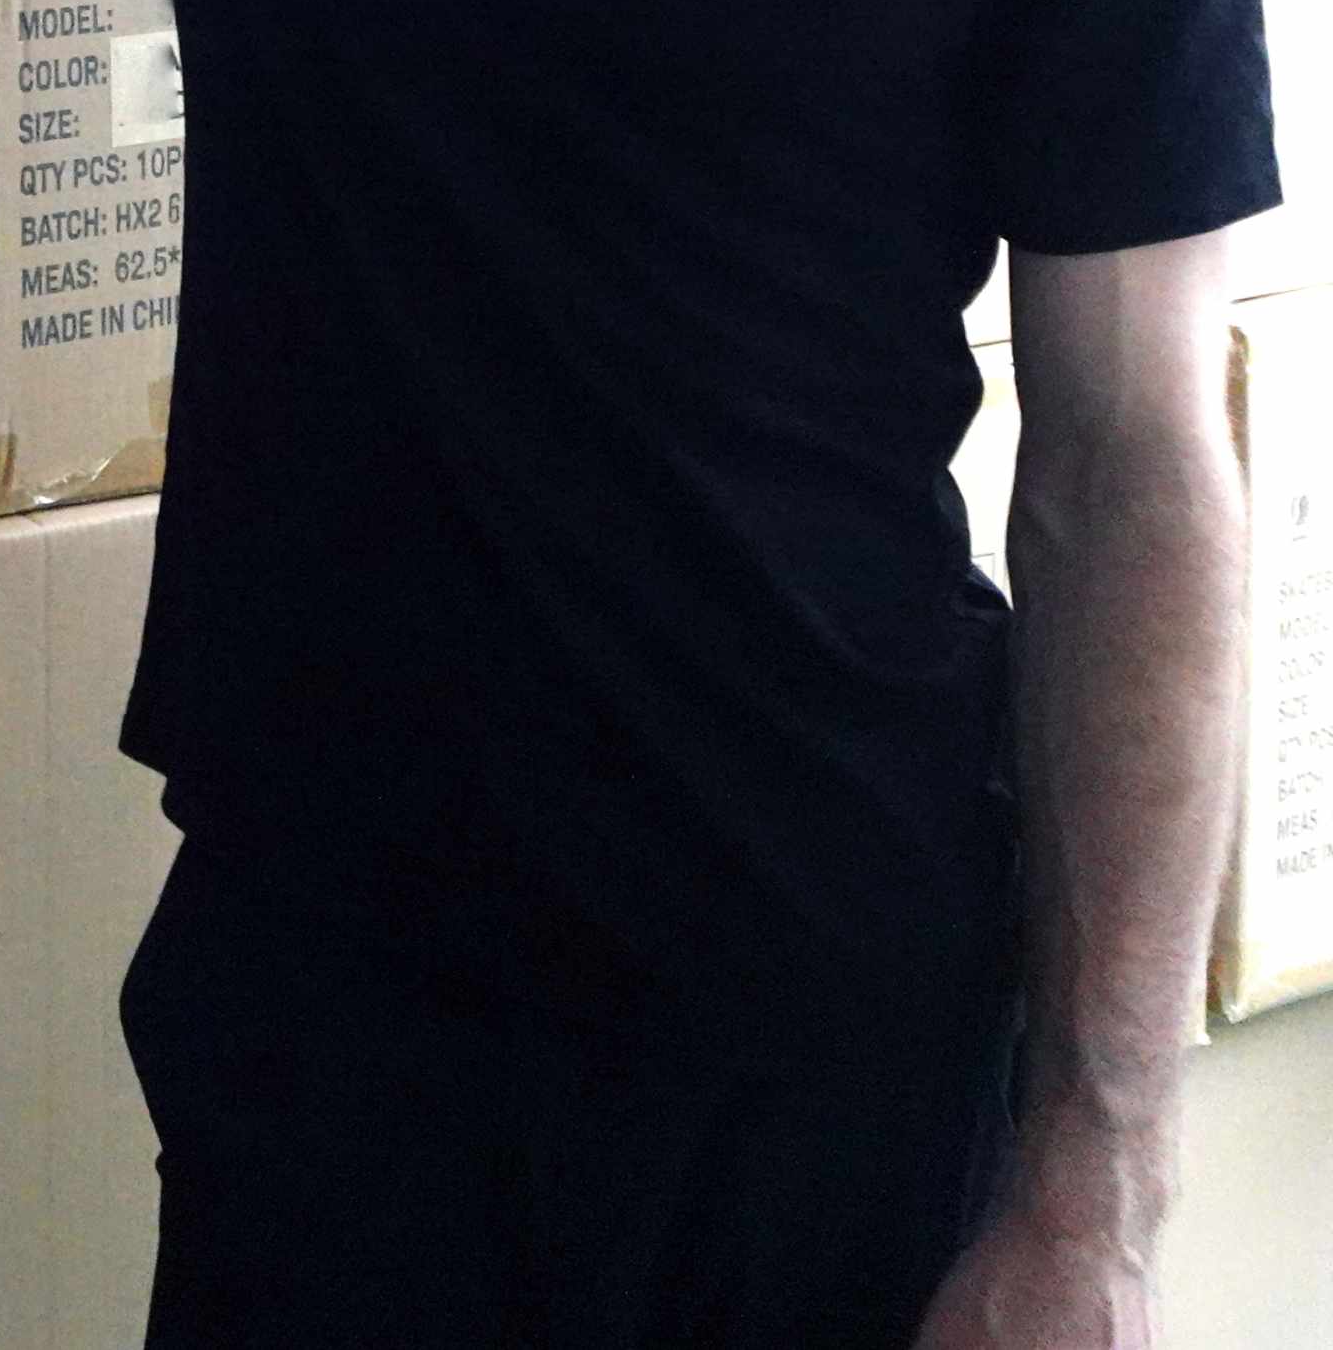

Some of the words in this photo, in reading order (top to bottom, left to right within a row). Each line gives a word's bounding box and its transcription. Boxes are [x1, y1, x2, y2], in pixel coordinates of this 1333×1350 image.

[18, 8, 114, 42] MODEL:
[18, 55, 107, 93] COLOR:
[19, 110, 80, 144] SIZE:
[20, 161, 66, 198] QTY
[73, 153, 127, 189] PCS:
[137, 146, 182, 180] 10P
[20, 207, 107, 248] BATCH:
[21, 262, 99, 300] MEAS:
[115, 246, 181, 283] 62.5
[21, 311, 92, 349] MADE
[101, 304, 125, 336] IN
